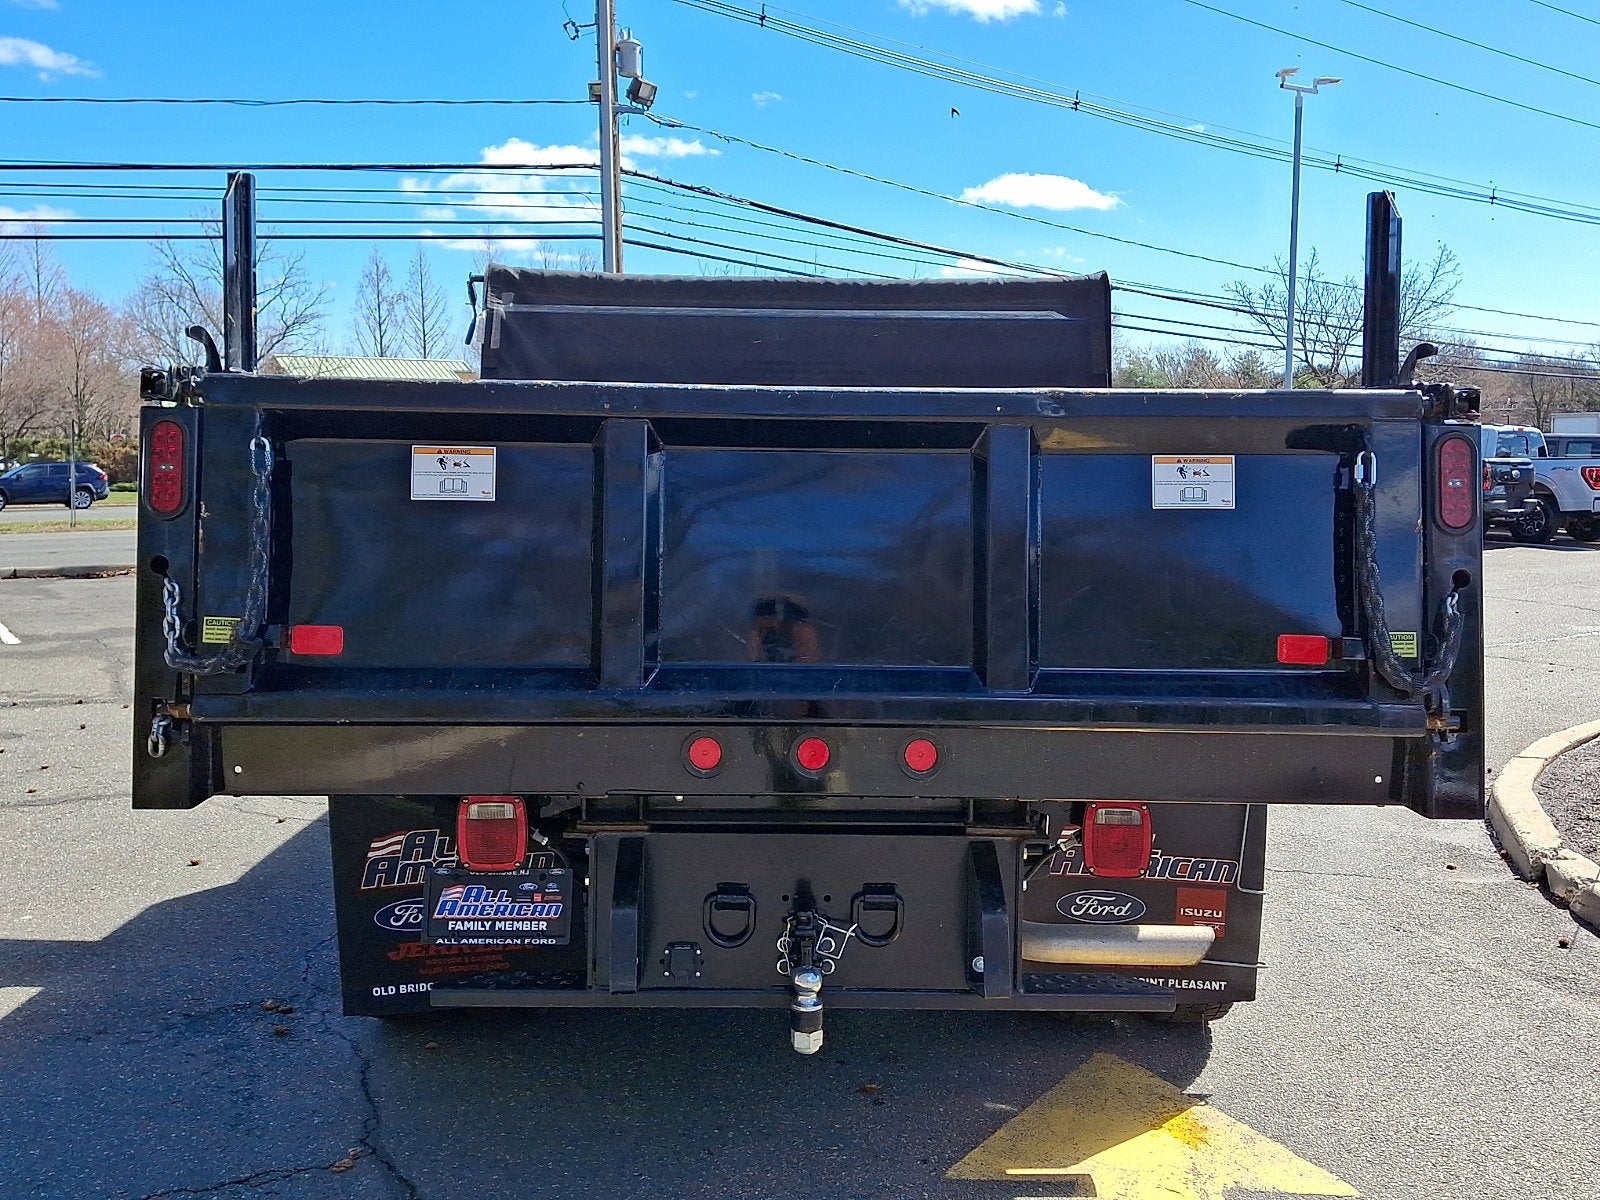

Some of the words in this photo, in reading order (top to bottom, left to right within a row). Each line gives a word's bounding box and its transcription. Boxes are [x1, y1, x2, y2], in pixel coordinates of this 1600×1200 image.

[461, 885, 512, 903] ALL
[433, 899, 563, 919] AMERICAN
[1070, 895, 1132, 917] Ford
[1180, 907, 1223, 918] ISUZU
[448, 920, 490, 931] FAMILY
[495, 920, 548, 931] MEMBER
[372, 986, 396, 996] OLD
[399, 982, 440, 993] BRIDG
[1168, 979, 1227, 991] PLEASANT
